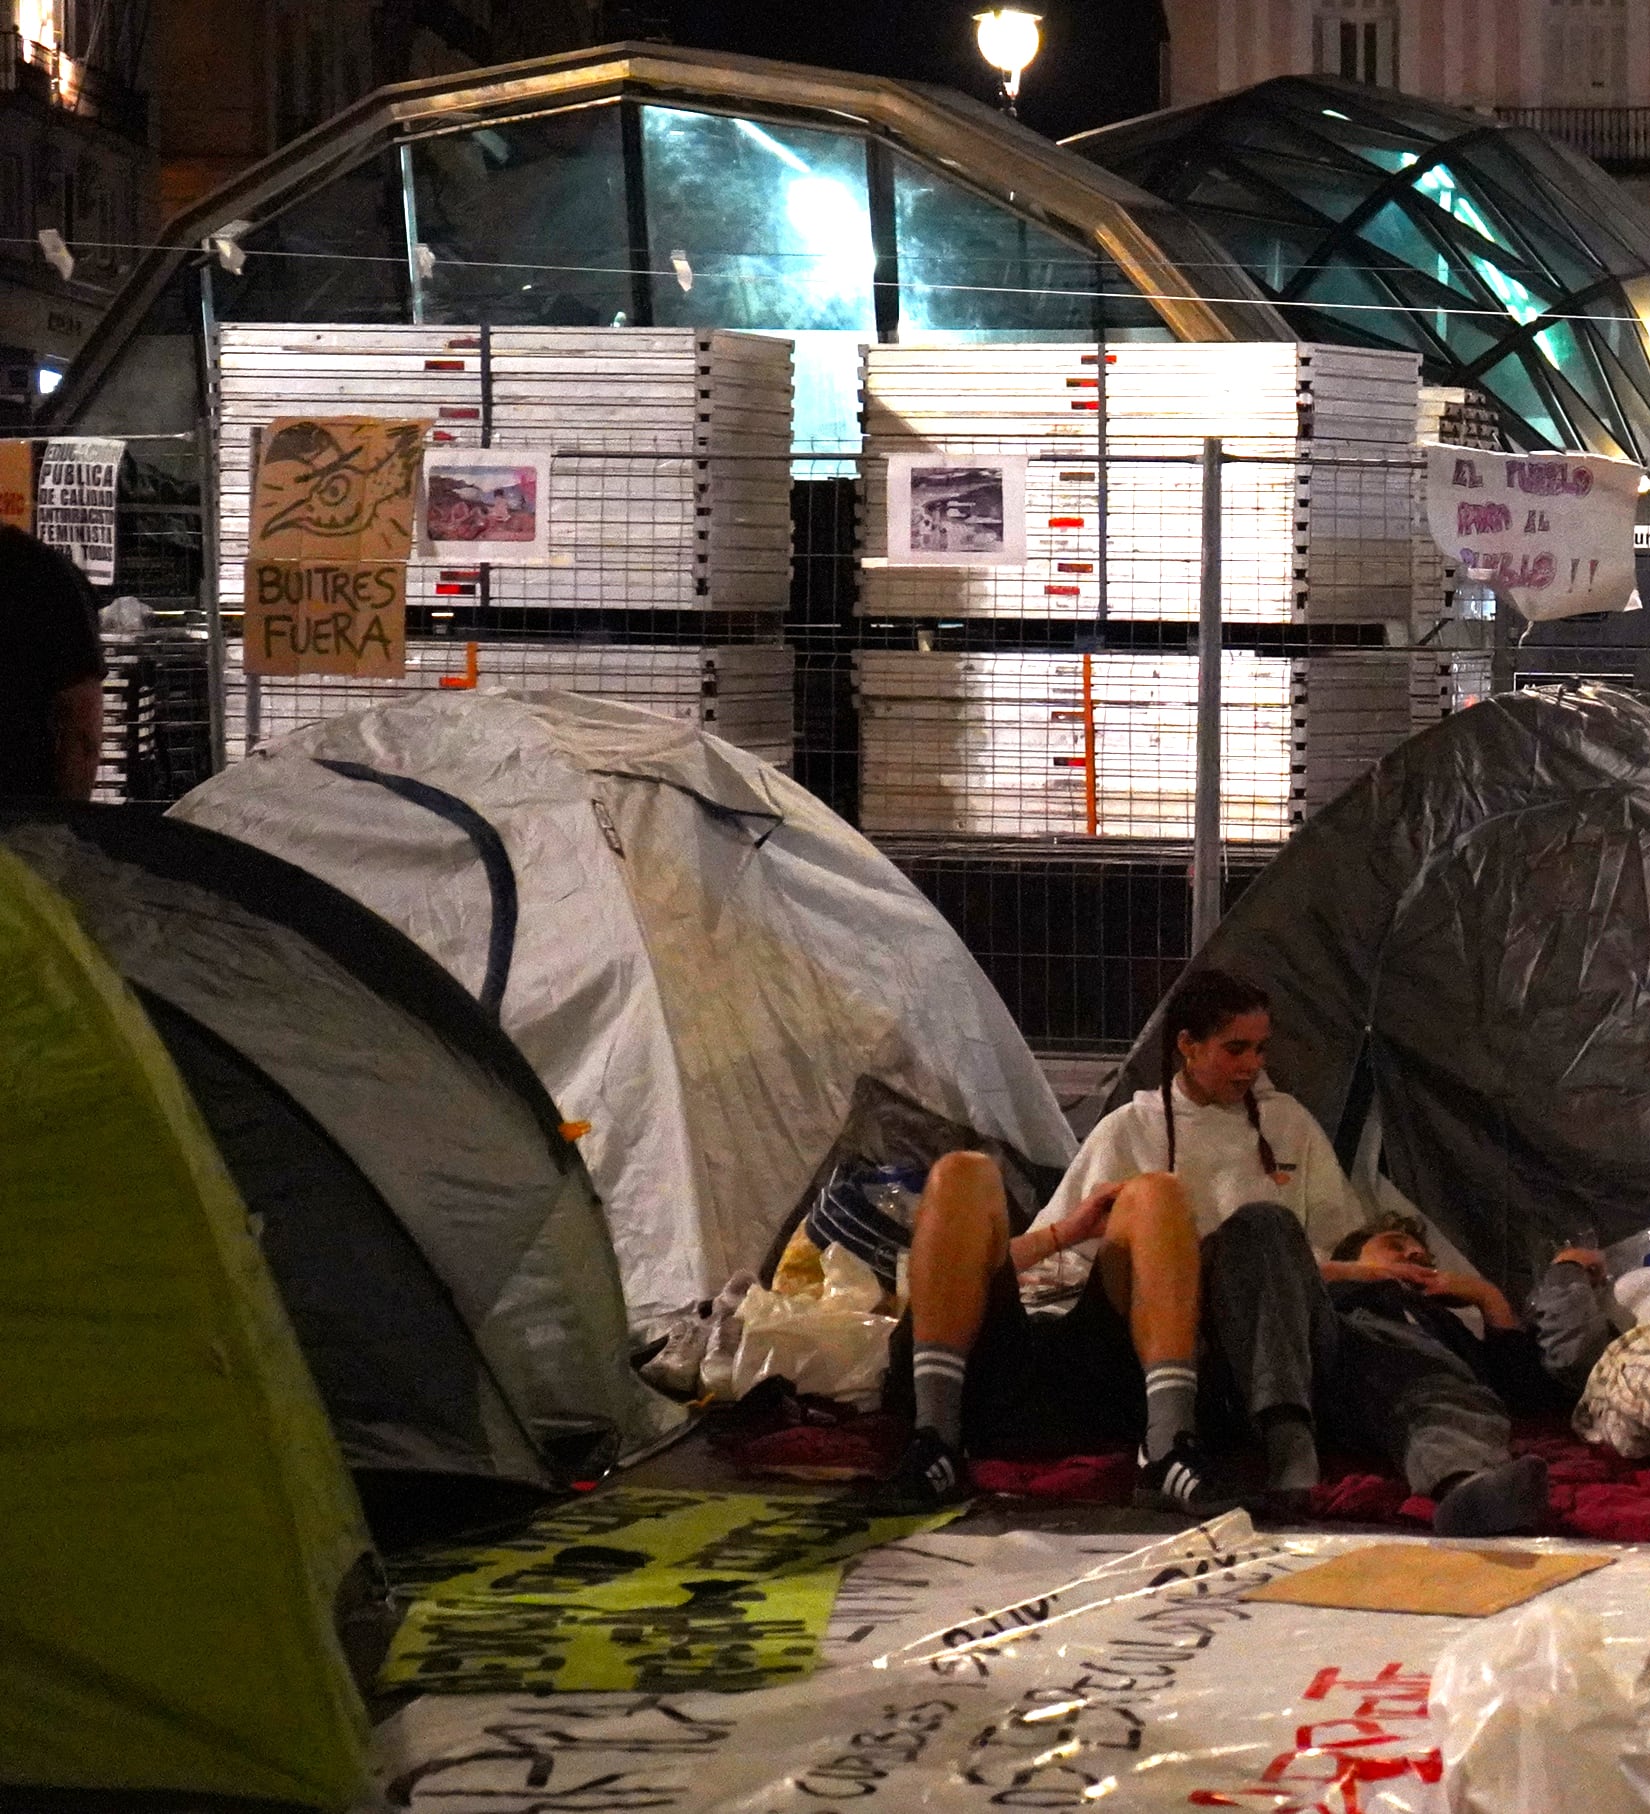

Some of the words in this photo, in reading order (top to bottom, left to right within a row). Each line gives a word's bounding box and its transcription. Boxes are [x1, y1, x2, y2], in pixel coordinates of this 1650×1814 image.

[60, 488, 114, 507] CALIDAD
[257, 565, 398, 612] BUITRES
[264, 612, 393, 661] FUERA
